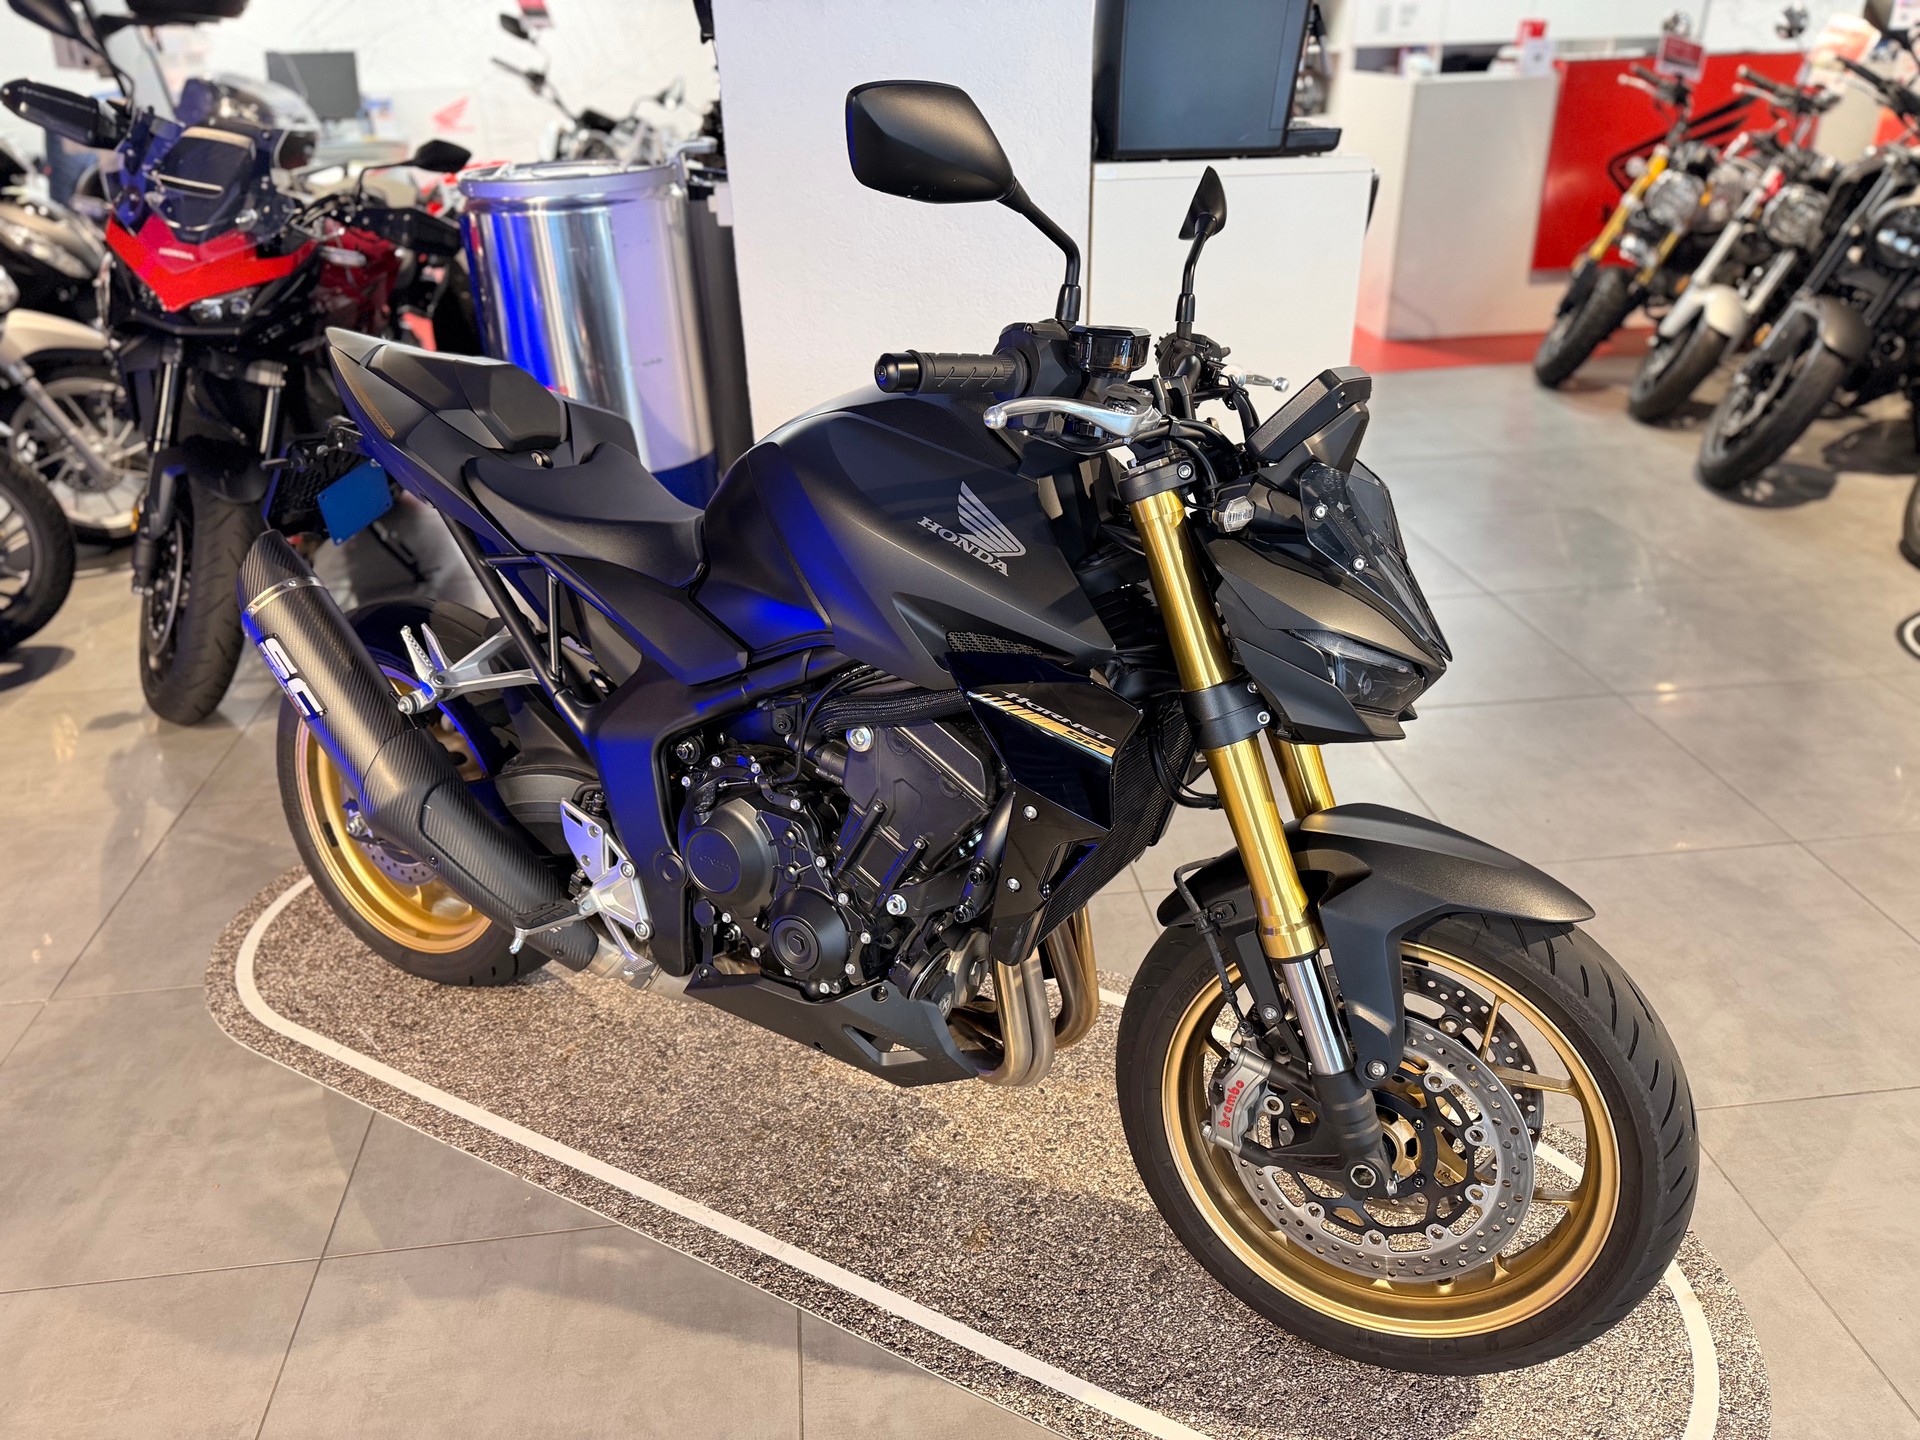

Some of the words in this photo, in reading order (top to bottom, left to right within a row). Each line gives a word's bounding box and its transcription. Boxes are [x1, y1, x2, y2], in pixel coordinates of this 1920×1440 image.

[917, 516, 1009, 577] HONDA
[1001, 690, 1117, 742] HORNET
[1063, 730, 1108, 750] SP
[1217, 1079, 1245, 1129] brembo
